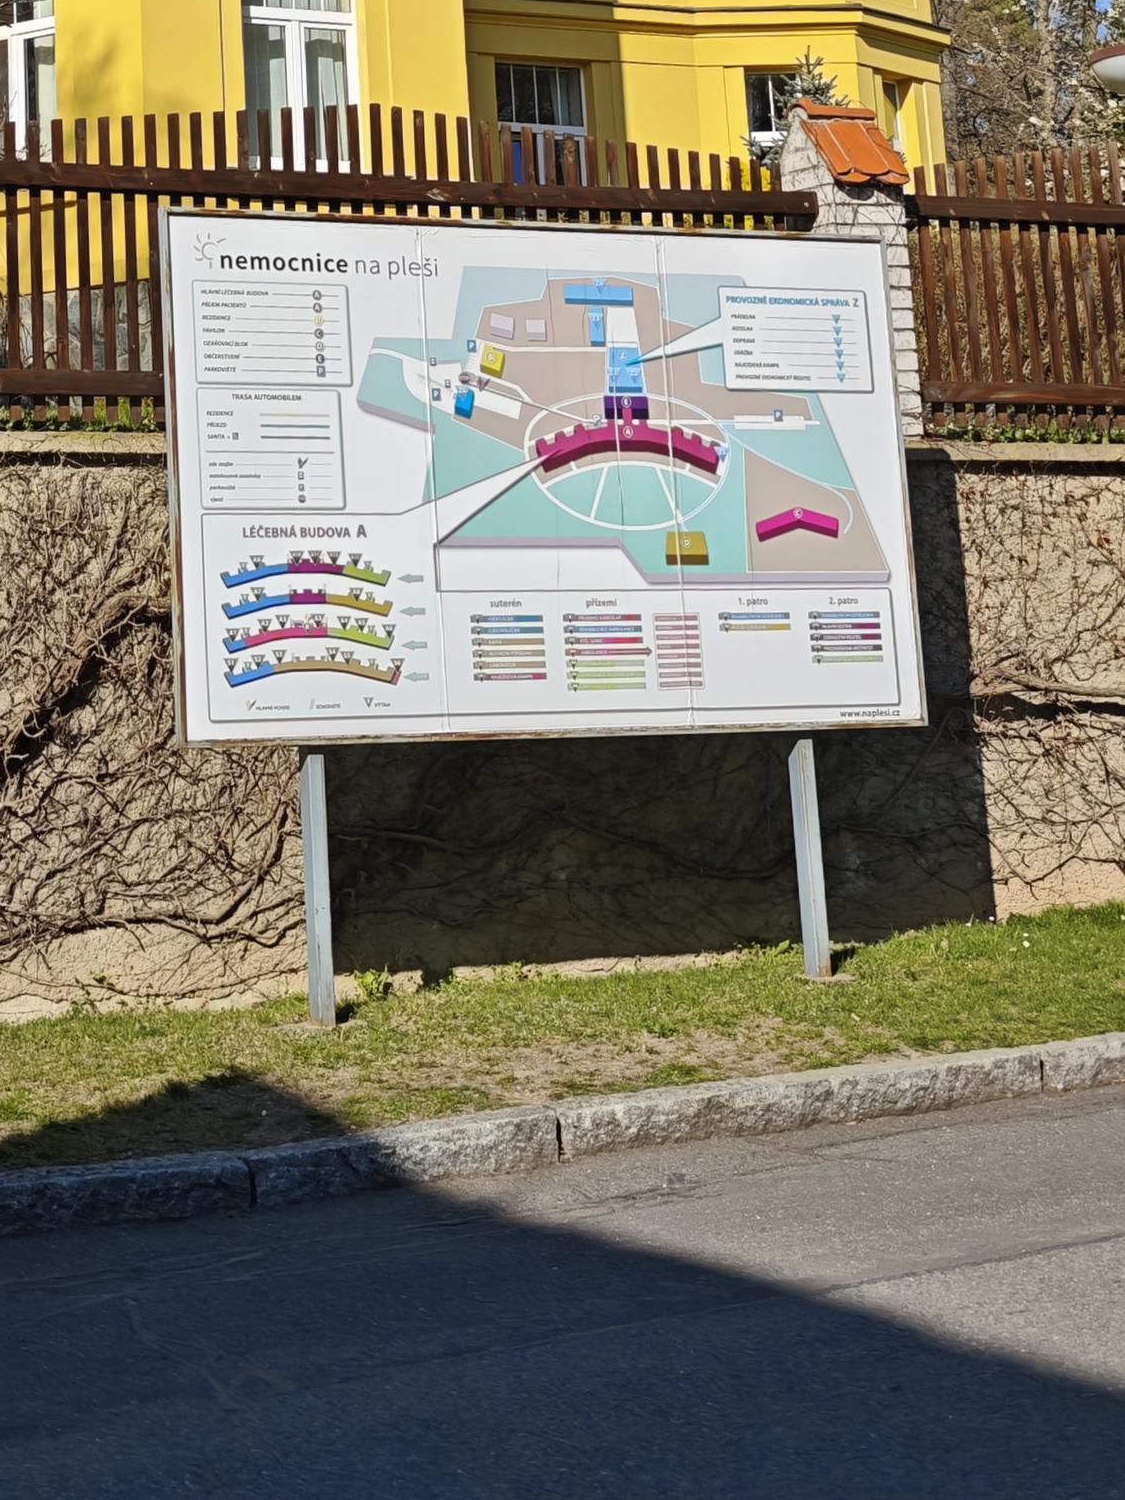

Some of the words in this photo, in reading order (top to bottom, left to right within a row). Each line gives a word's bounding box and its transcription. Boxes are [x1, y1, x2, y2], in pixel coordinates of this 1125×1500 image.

[219, 252, 349, 273] nemocnice
[354, 258, 380, 275] na
[387, 255, 439, 280] pleši
[242, 524, 298, 539] LÉČEBNÁ
[300, 527, 351, 539] BUDOVA
[356, 524, 367, 538] A
[490, 598, 522, 608] suterén
[586, 598, 618, 608] přízemí
[746, 598, 769, 607] patro
[828, 597, 836, 605] 2.
[837, 597, 858, 606] patro
[840, 708, 900, 718] www.naplesi.cz
